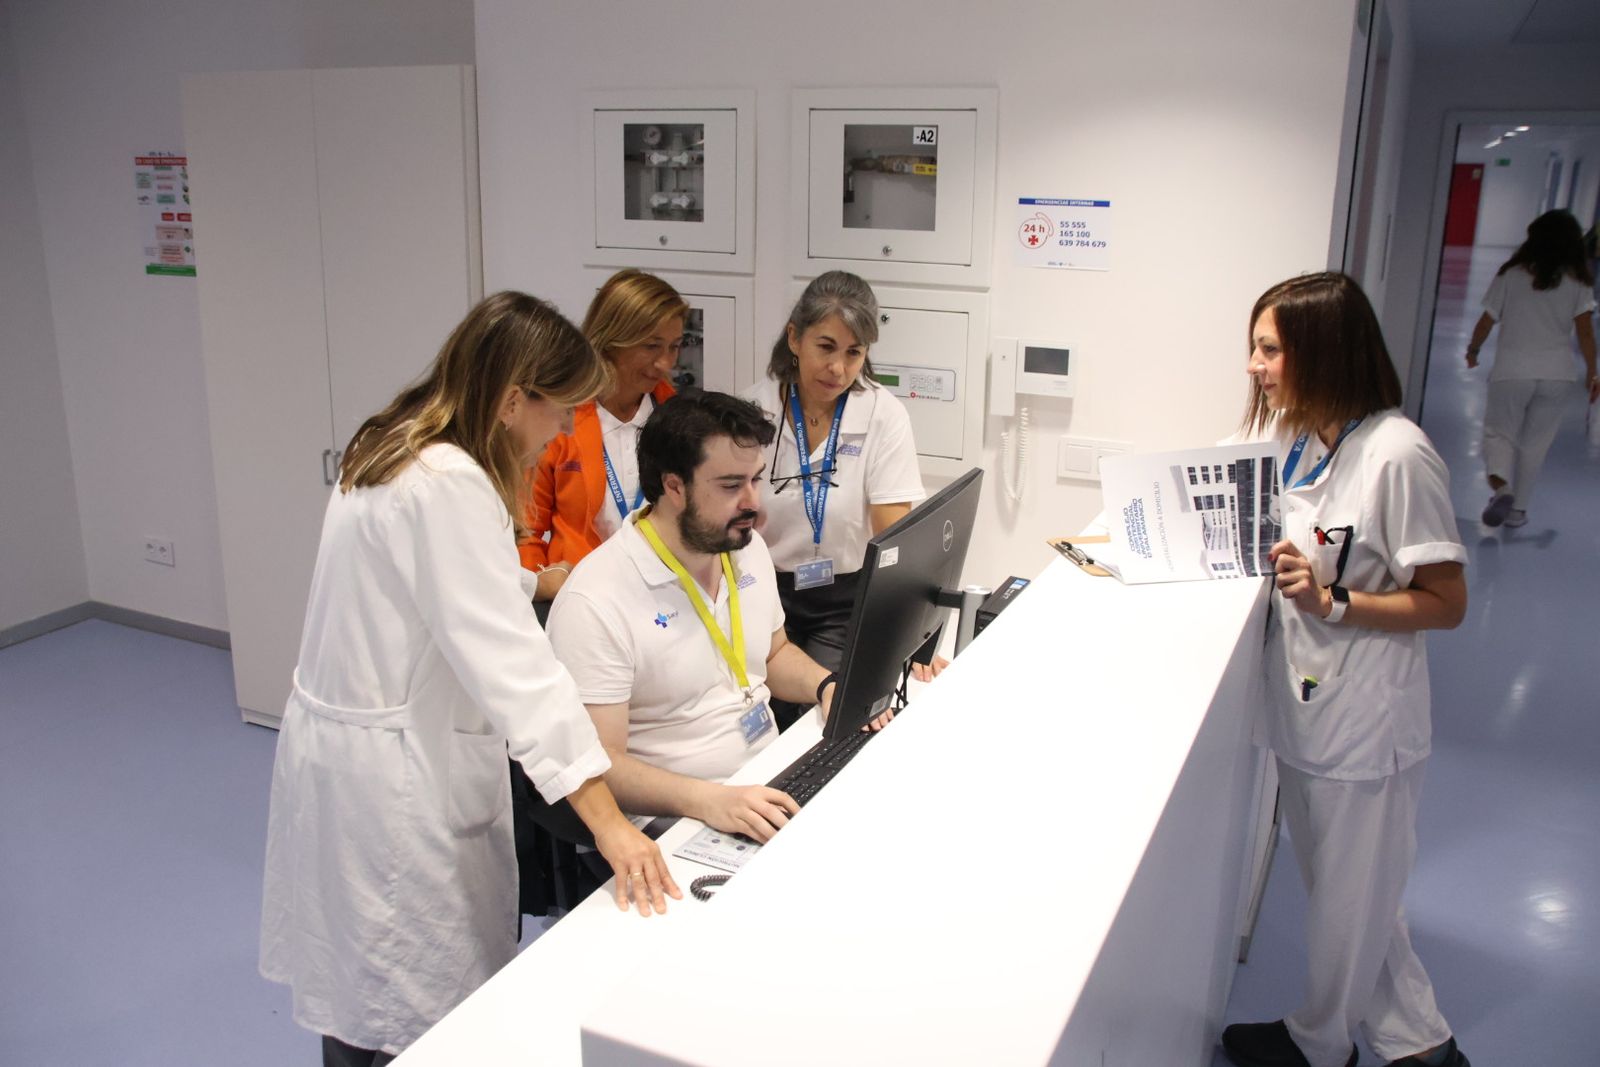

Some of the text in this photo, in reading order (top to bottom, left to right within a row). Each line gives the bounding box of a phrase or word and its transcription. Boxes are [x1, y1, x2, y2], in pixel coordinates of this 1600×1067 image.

[1023, 224, 1045, 233] 24 h
[1071, 221, 1086, 229] 555
[1060, 230, 1074, 238] 165
[1059, 239, 1073, 247] 639
[1091, 240, 1107, 248] 679
[1124, 507, 1135, 551] COMPLEJO
